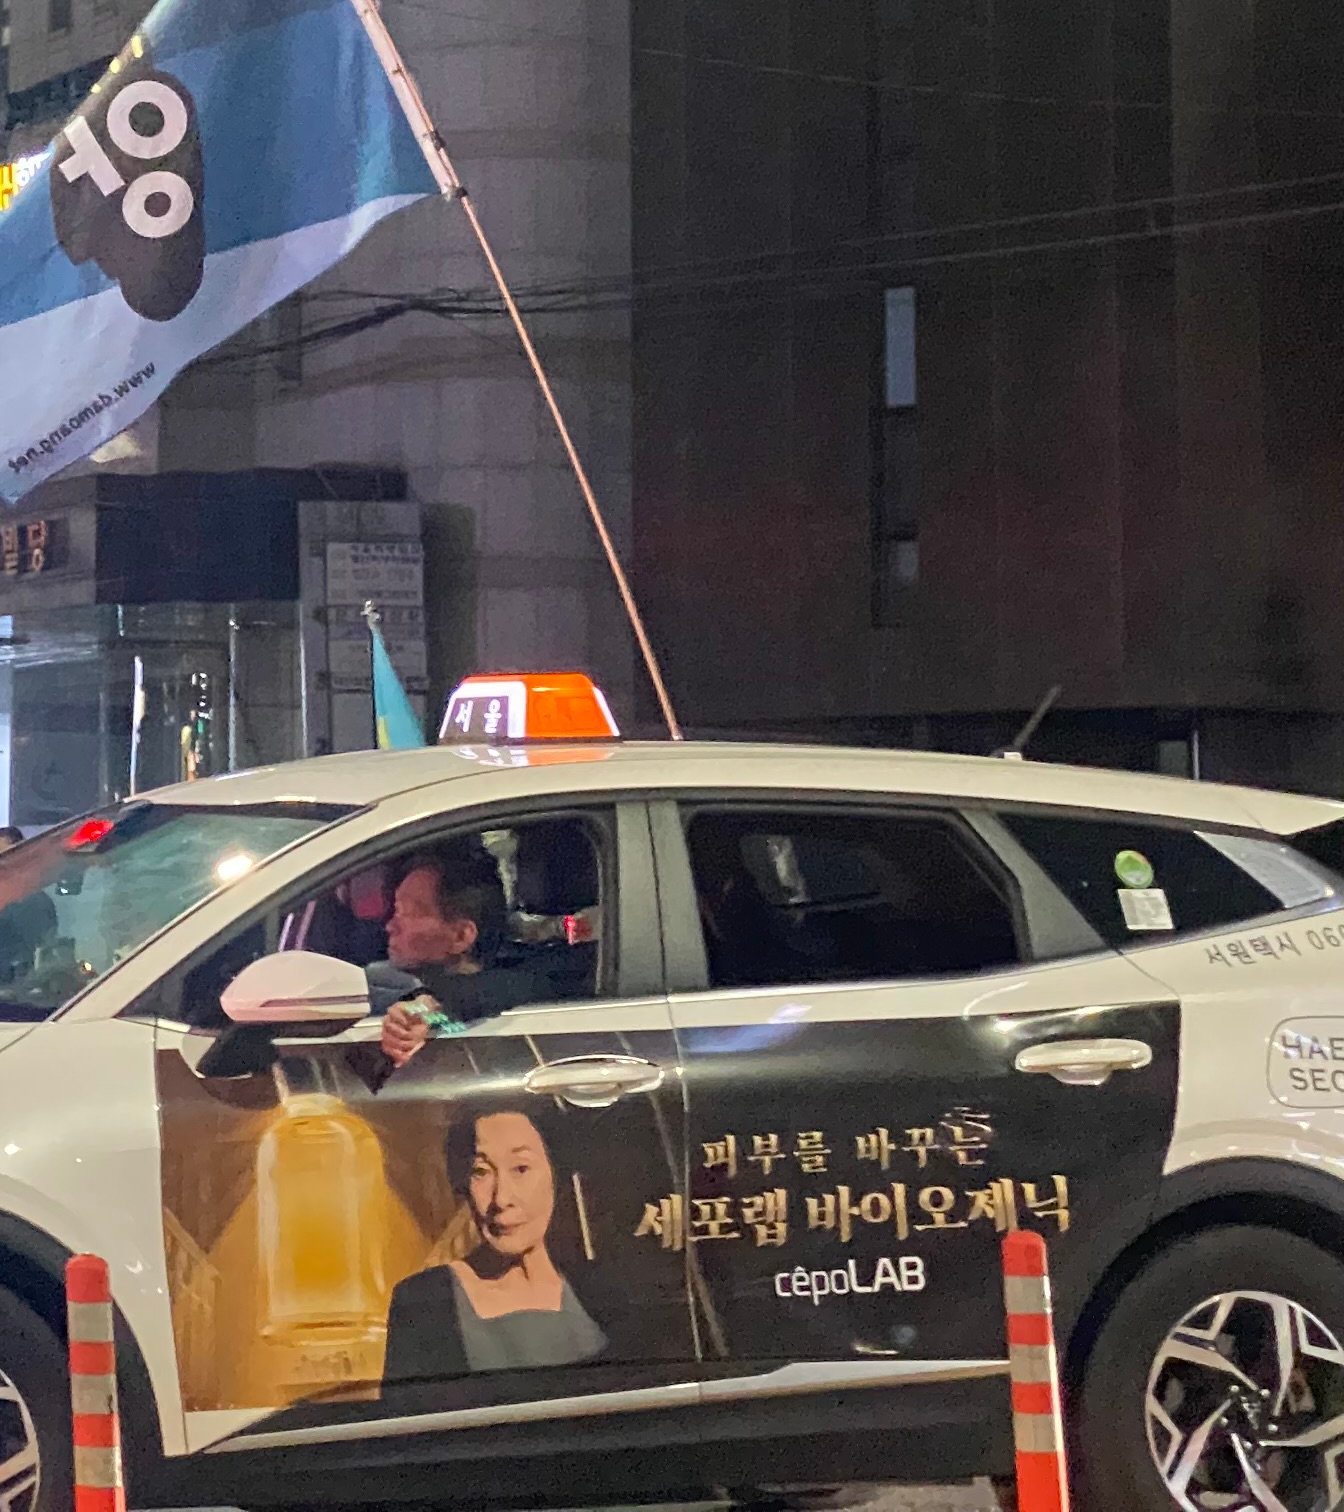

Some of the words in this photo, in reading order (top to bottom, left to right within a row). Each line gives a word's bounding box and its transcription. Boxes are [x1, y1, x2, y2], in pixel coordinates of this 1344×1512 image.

[454, 698, 503, 734] 서울
[1204, 931, 1302, 969] 서원택시
[701, 1130, 832, 1178] 피부를
[855, 1126, 990, 1171] 바꾸는
[633, 1187, 788, 1251] 세포랩
[805, 1173, 1071, 1244] 바이오제닉
[774, 1255, 927, 1307] cêpoLAB
